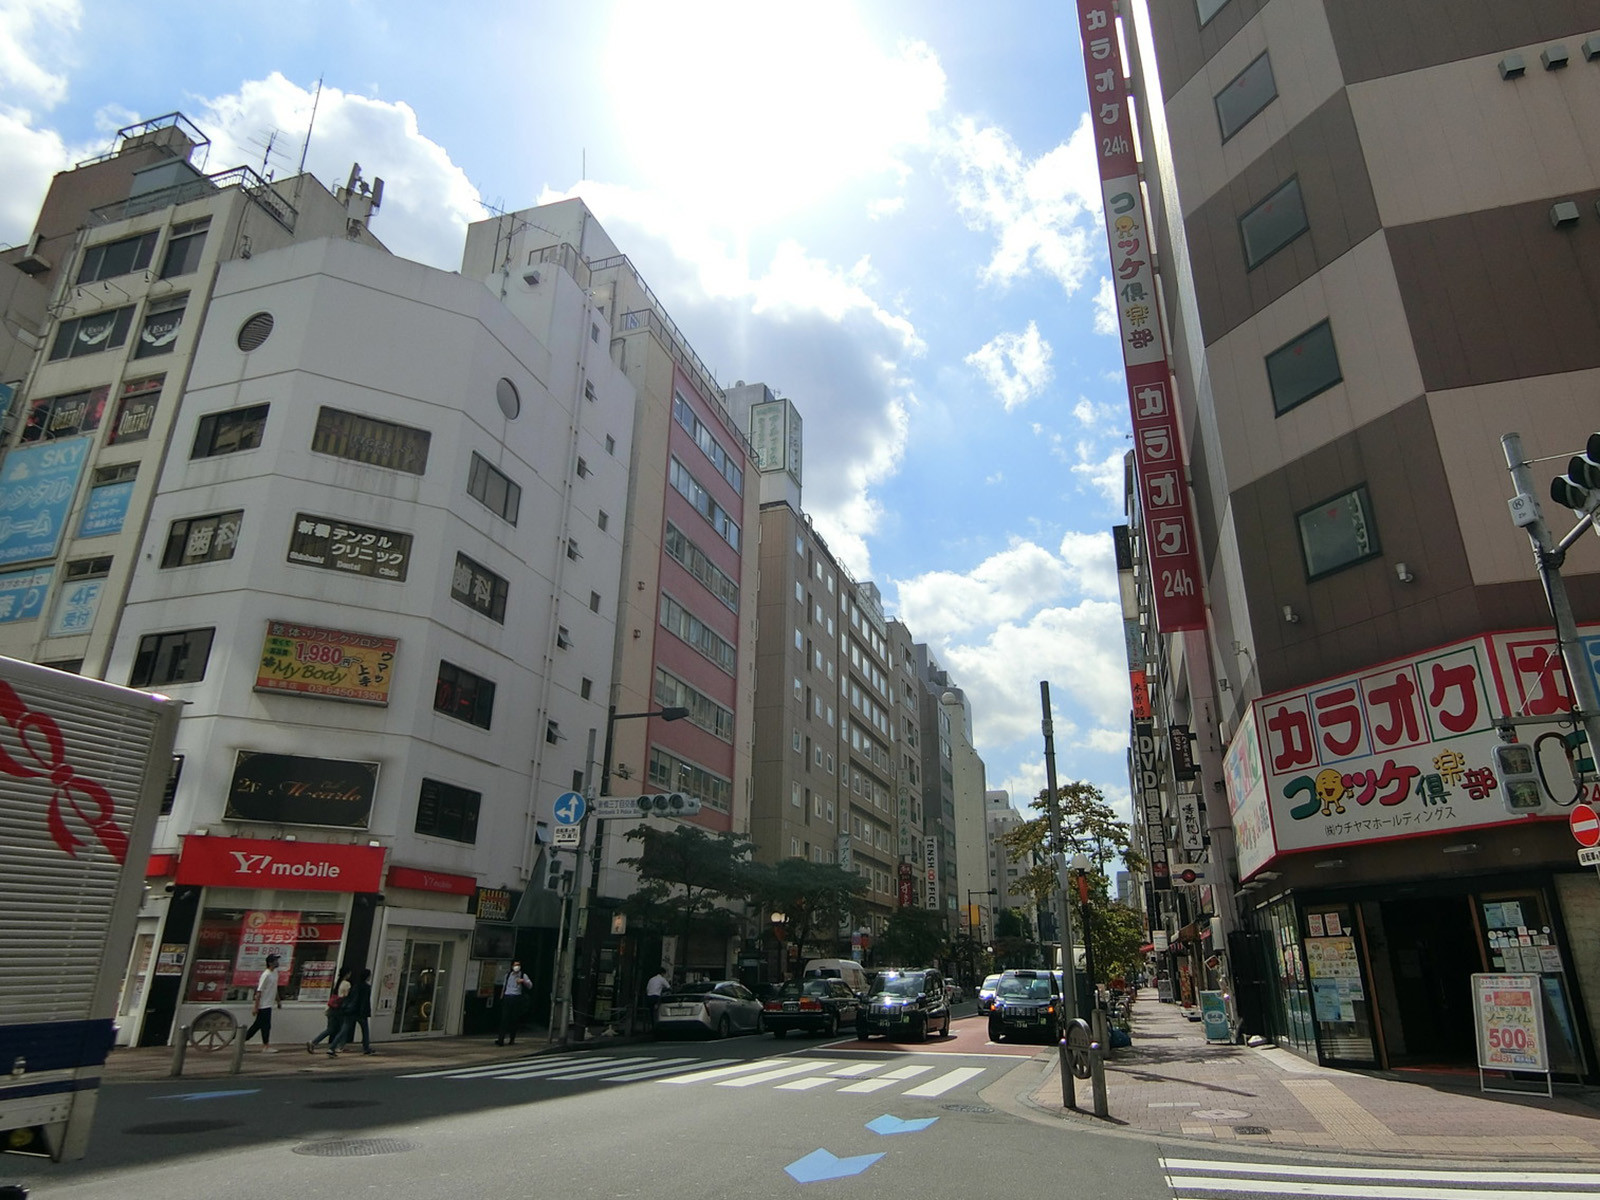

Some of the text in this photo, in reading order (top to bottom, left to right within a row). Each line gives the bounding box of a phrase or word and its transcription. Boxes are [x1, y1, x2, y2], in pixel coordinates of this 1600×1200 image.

[1086, 9, 1120, 125] カラオケ
[1103, 136, 1129, 157] 24h
[41, 445, 83, 468] SKY
[1137, 387, 1182, 554] カラオケ
[186, 521, 241, 556] 歯科
[332, 528, 393, 548] デンタル
[331, 543, 404, 566] クリニック
[70, 585, 98, 605] 4F
[453, 562, 493, 607] 歯科
[1161, 569, 1194, 598] 24h
[272, 660, 347, 685] My Body
[1268, 662, 1477, 770] カラオケ
